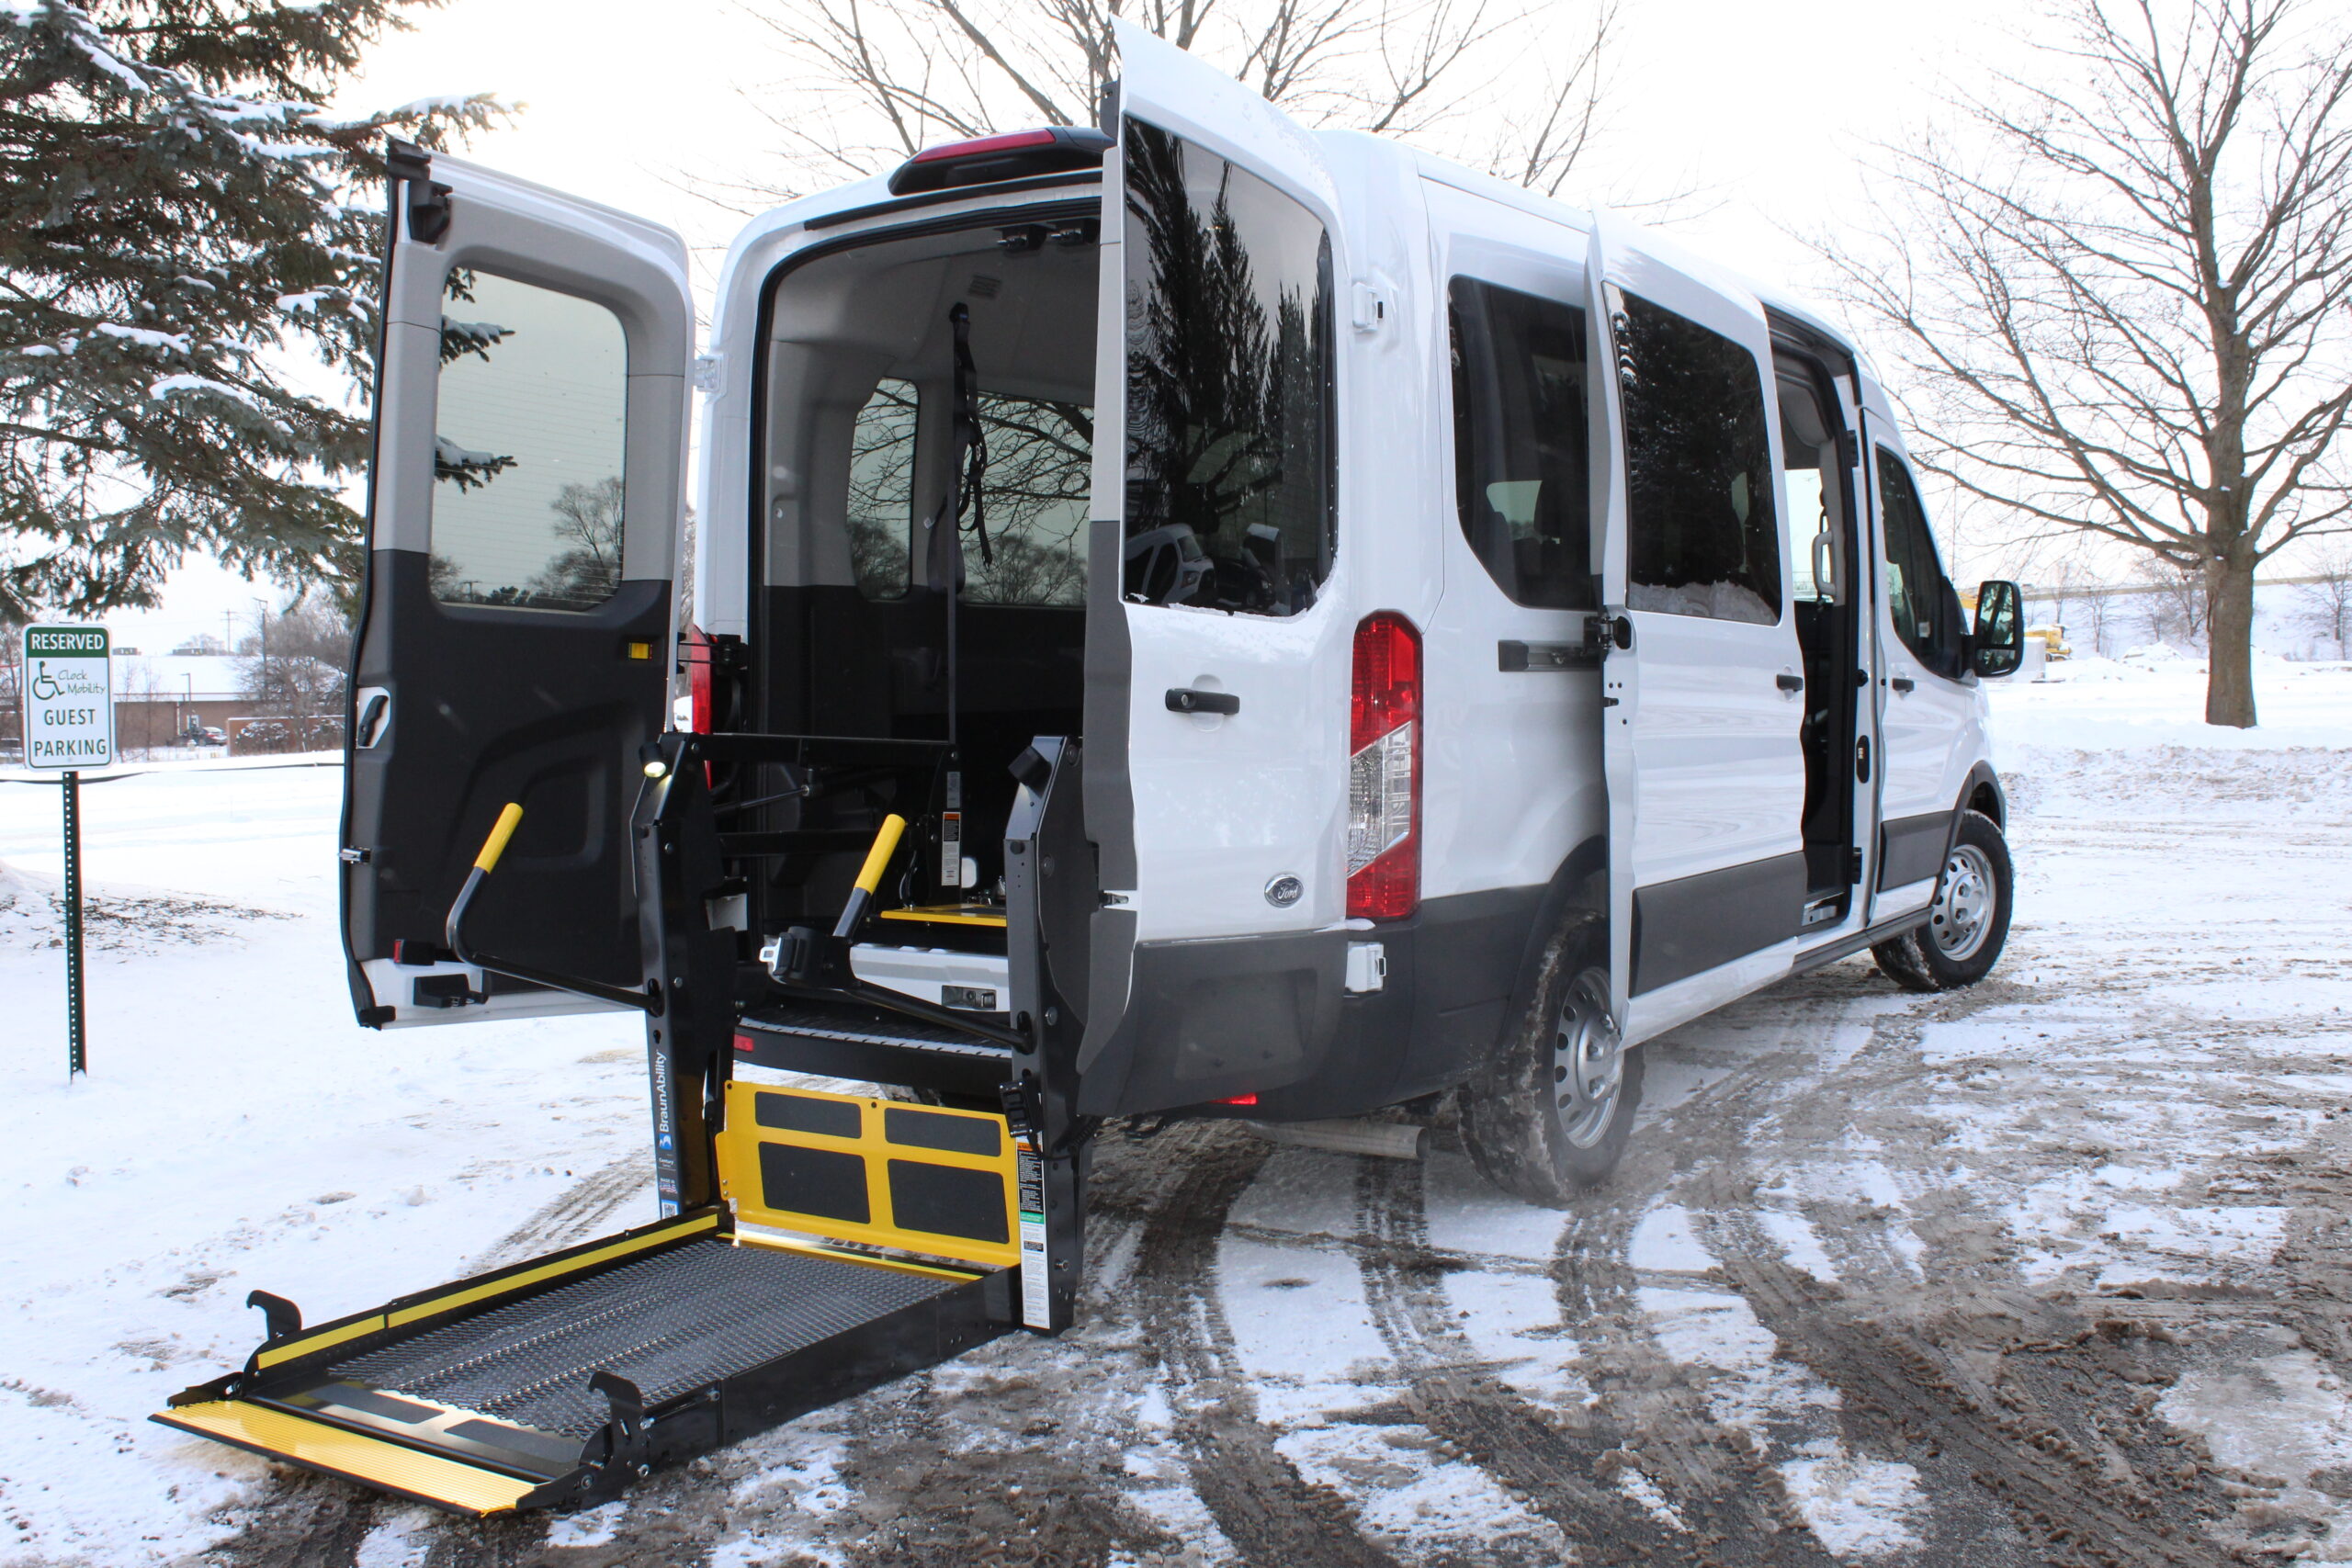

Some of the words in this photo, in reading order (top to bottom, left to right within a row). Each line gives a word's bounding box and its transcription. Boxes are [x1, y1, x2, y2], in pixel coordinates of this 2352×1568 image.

[31, 633, 104, 650] RESERVED
[44, 708, 96, 726] GUEST
[35, 739, 107, 757] PARKING
[1277, 885, 1298, 899] Ford
[655, 1051, 670, 1133] BraunAbility
